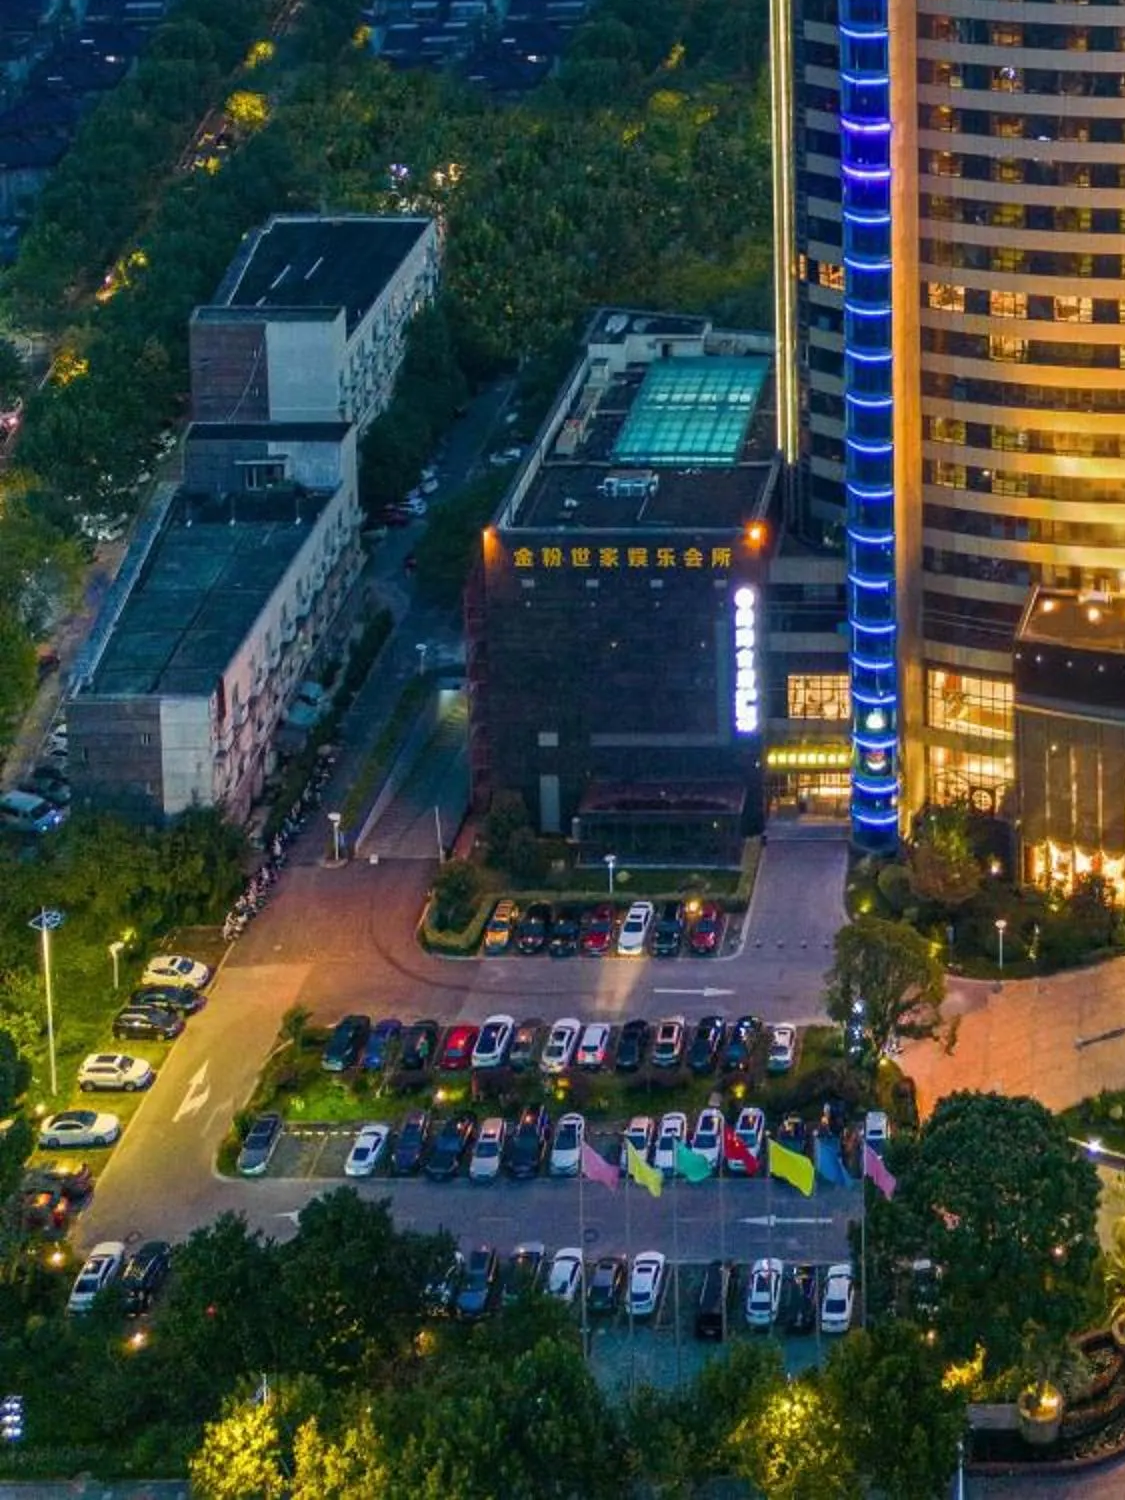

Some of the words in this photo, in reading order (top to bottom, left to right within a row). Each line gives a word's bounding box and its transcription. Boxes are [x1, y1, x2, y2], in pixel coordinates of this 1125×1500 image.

[513, 548, 732, 568] 金粉世家娱乐会所
